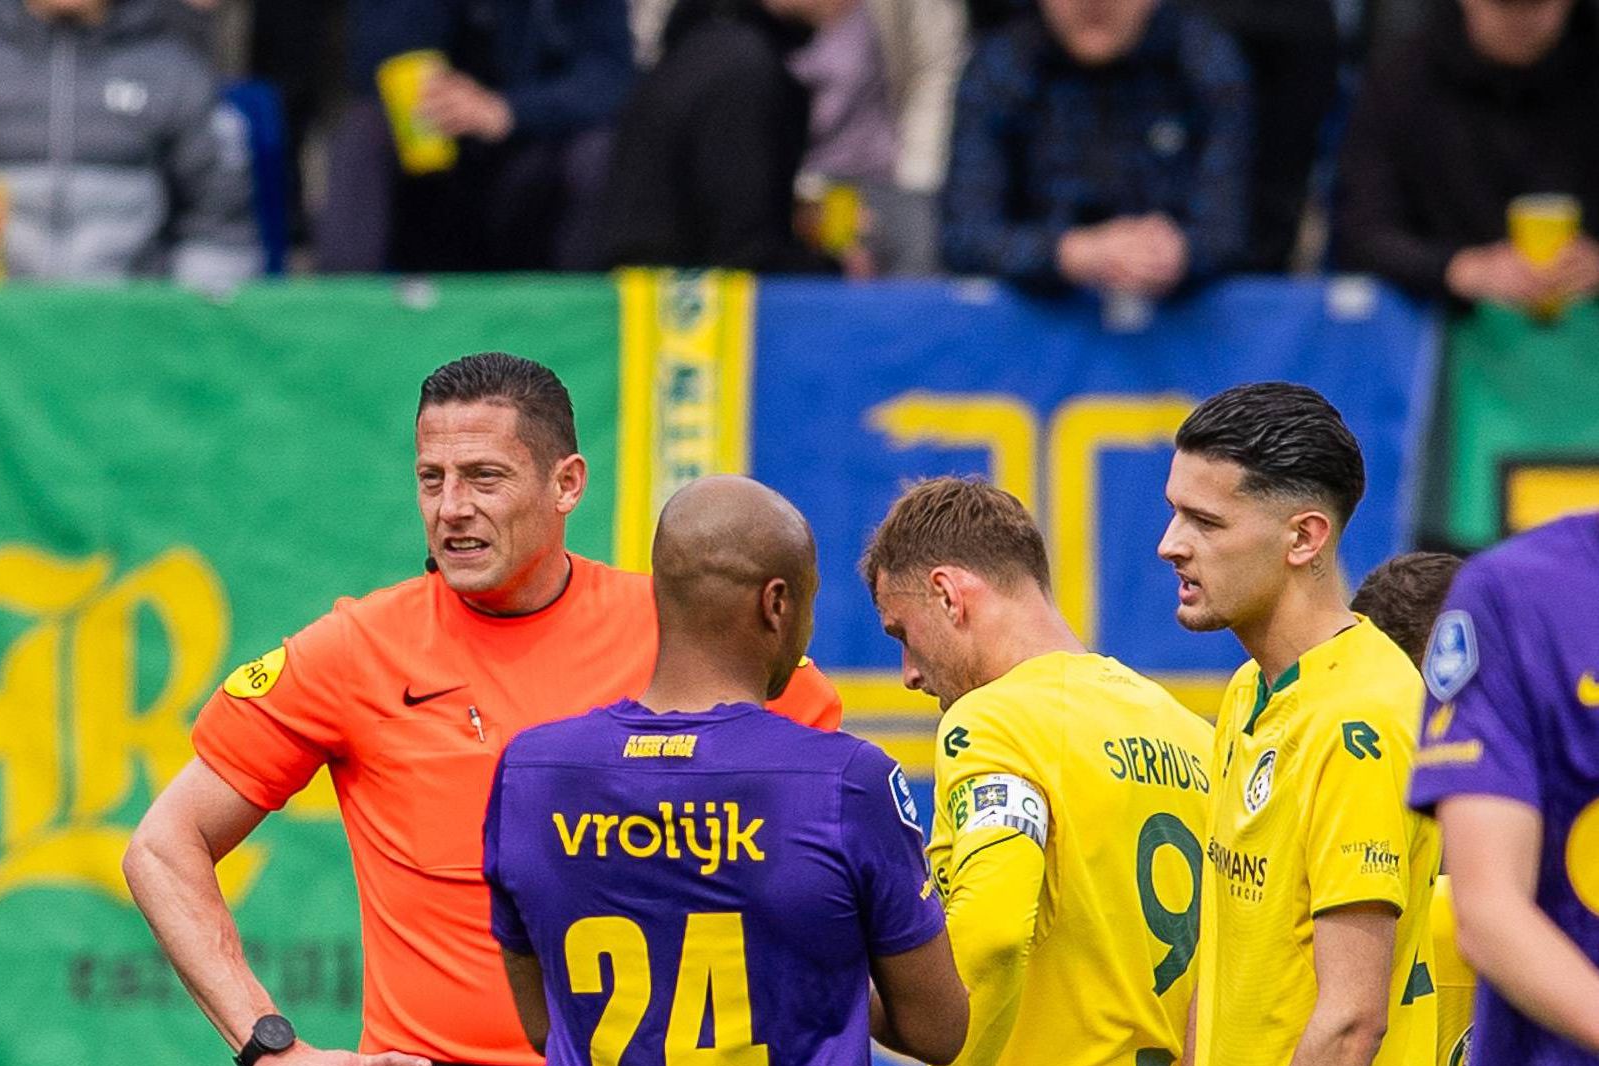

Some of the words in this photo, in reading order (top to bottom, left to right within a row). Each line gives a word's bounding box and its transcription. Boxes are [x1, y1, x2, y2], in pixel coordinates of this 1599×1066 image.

[1104, 736, 1209, 793] SIERHUIS
[553, 802, 764, 875] vrolijk
[1137, 812, 1203, 997] 9
